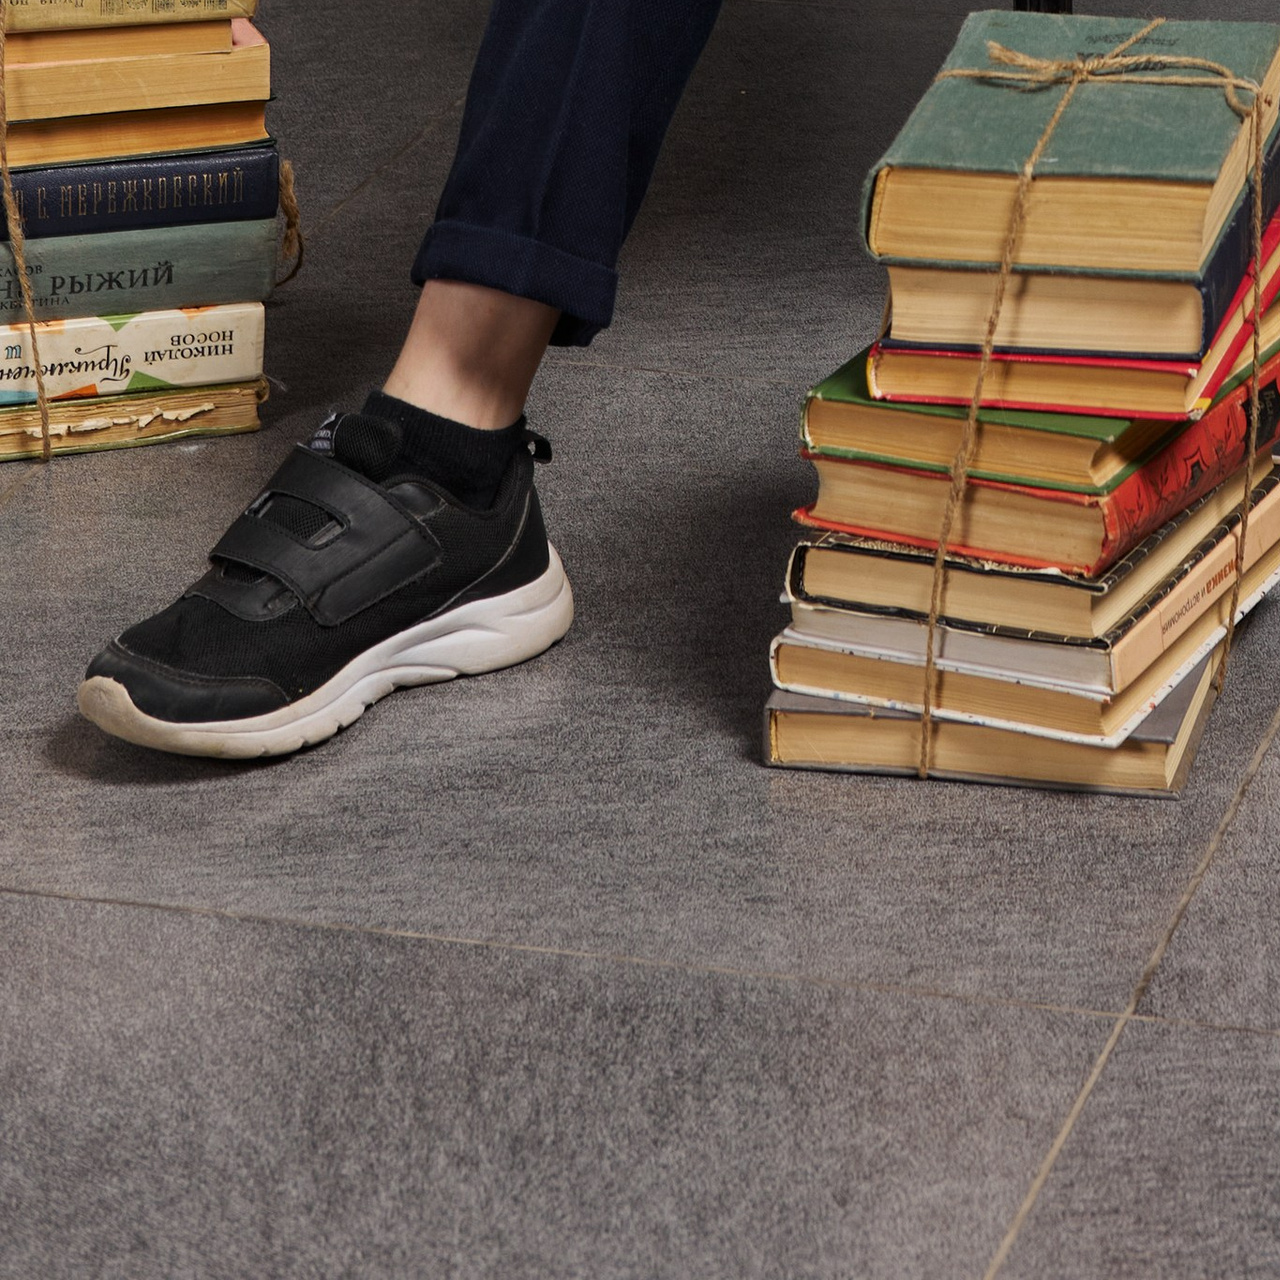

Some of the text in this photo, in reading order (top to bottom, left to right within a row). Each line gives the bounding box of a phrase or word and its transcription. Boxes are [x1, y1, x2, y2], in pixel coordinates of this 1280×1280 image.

[61, 167, 244, 218] МЕРЕЖКОВСКИЙ
[50, 260, 175, 297] РЫЖИЙ
[144, 344, 234, 365] НИКОЛАЙ
[170, 330, 234, 346] НОСОВ
[1206, 558, 1238, 594] изика
